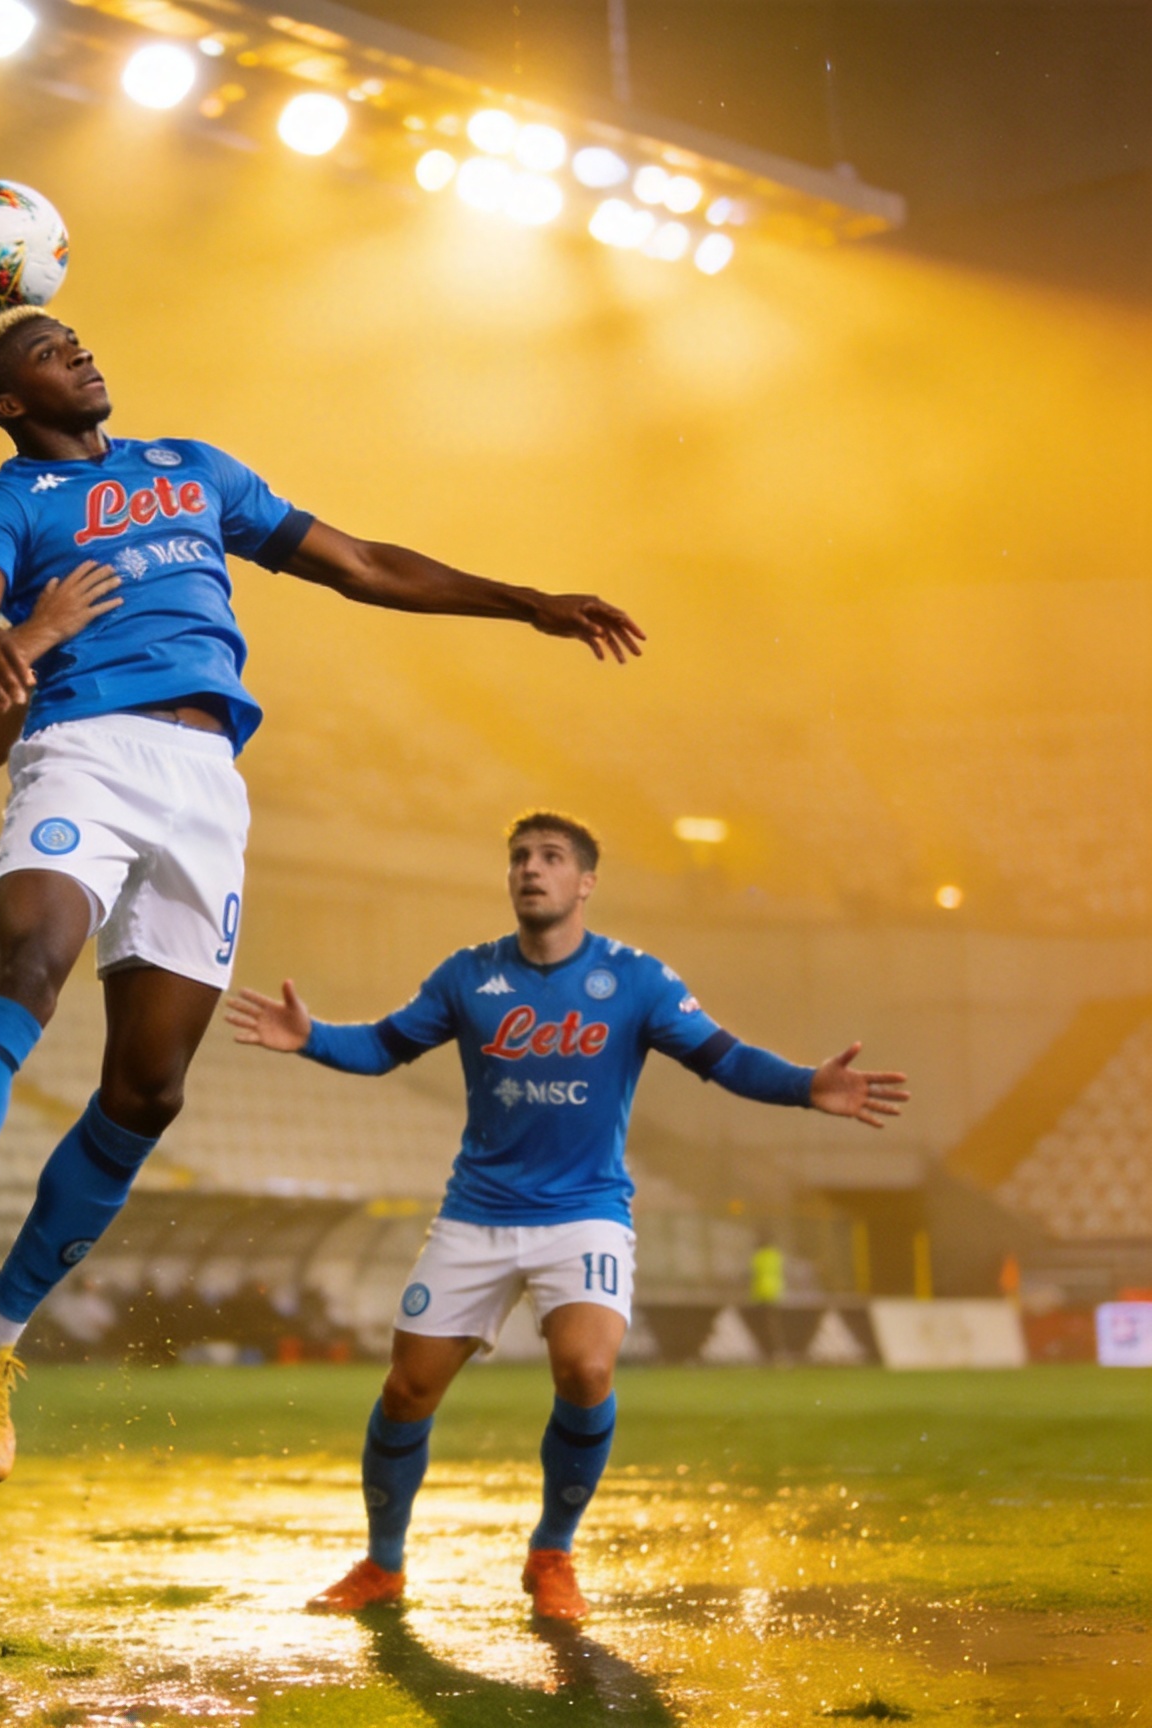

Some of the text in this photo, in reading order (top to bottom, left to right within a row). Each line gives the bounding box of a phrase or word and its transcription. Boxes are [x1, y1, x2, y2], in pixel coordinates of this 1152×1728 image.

[74, 476, 206, 546] Lete
[215, 892, 239, 966] 9
[481, 1004, 609, 1060] Lete
[526, 1080, 589, 1105] MSC
[581, 1252, 617, 1296] 10
